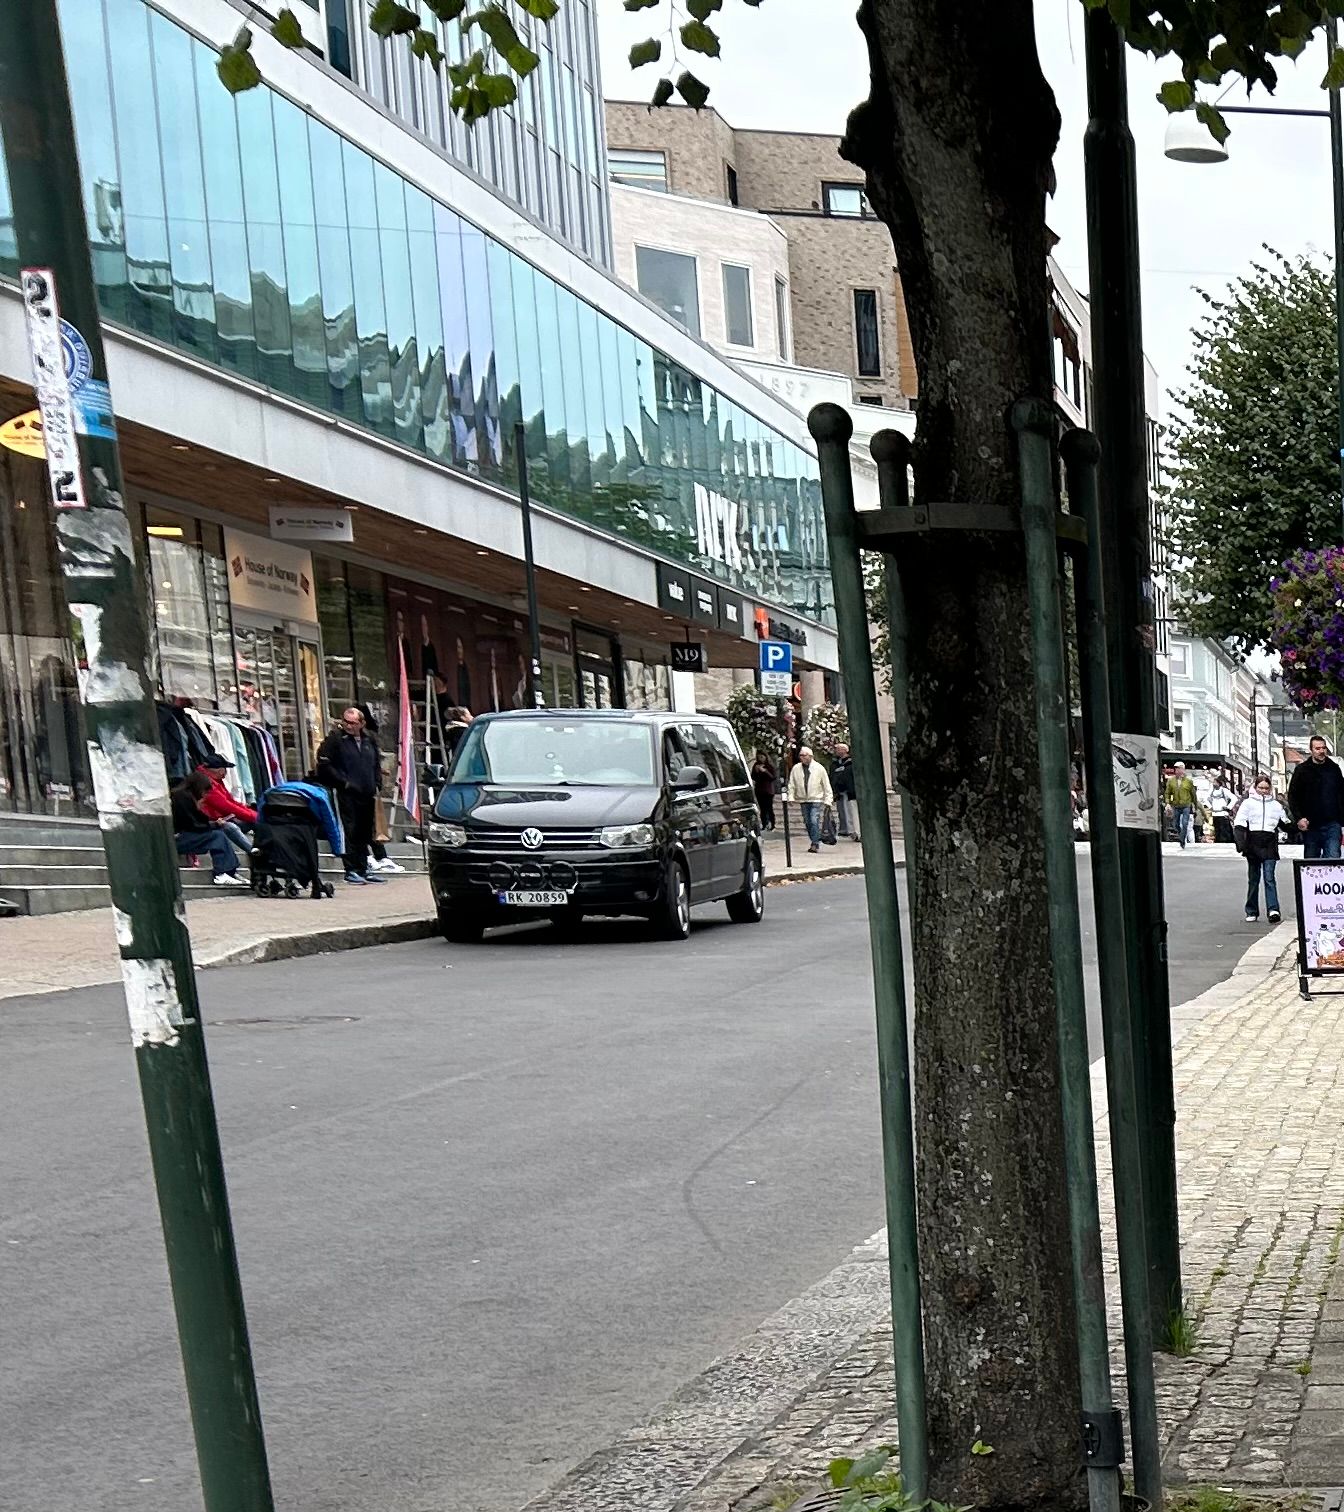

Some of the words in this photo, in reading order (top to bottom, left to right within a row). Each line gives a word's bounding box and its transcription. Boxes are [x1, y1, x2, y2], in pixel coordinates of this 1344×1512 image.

[245, 557, 266, 574] House
[274, 564, 298, 586] Norway
[675, 647, 699, 661] M9
[767, 646, 785, 669] P
[507, 893, 524, 903] RK
[528, 893, 565, 903] 20859
